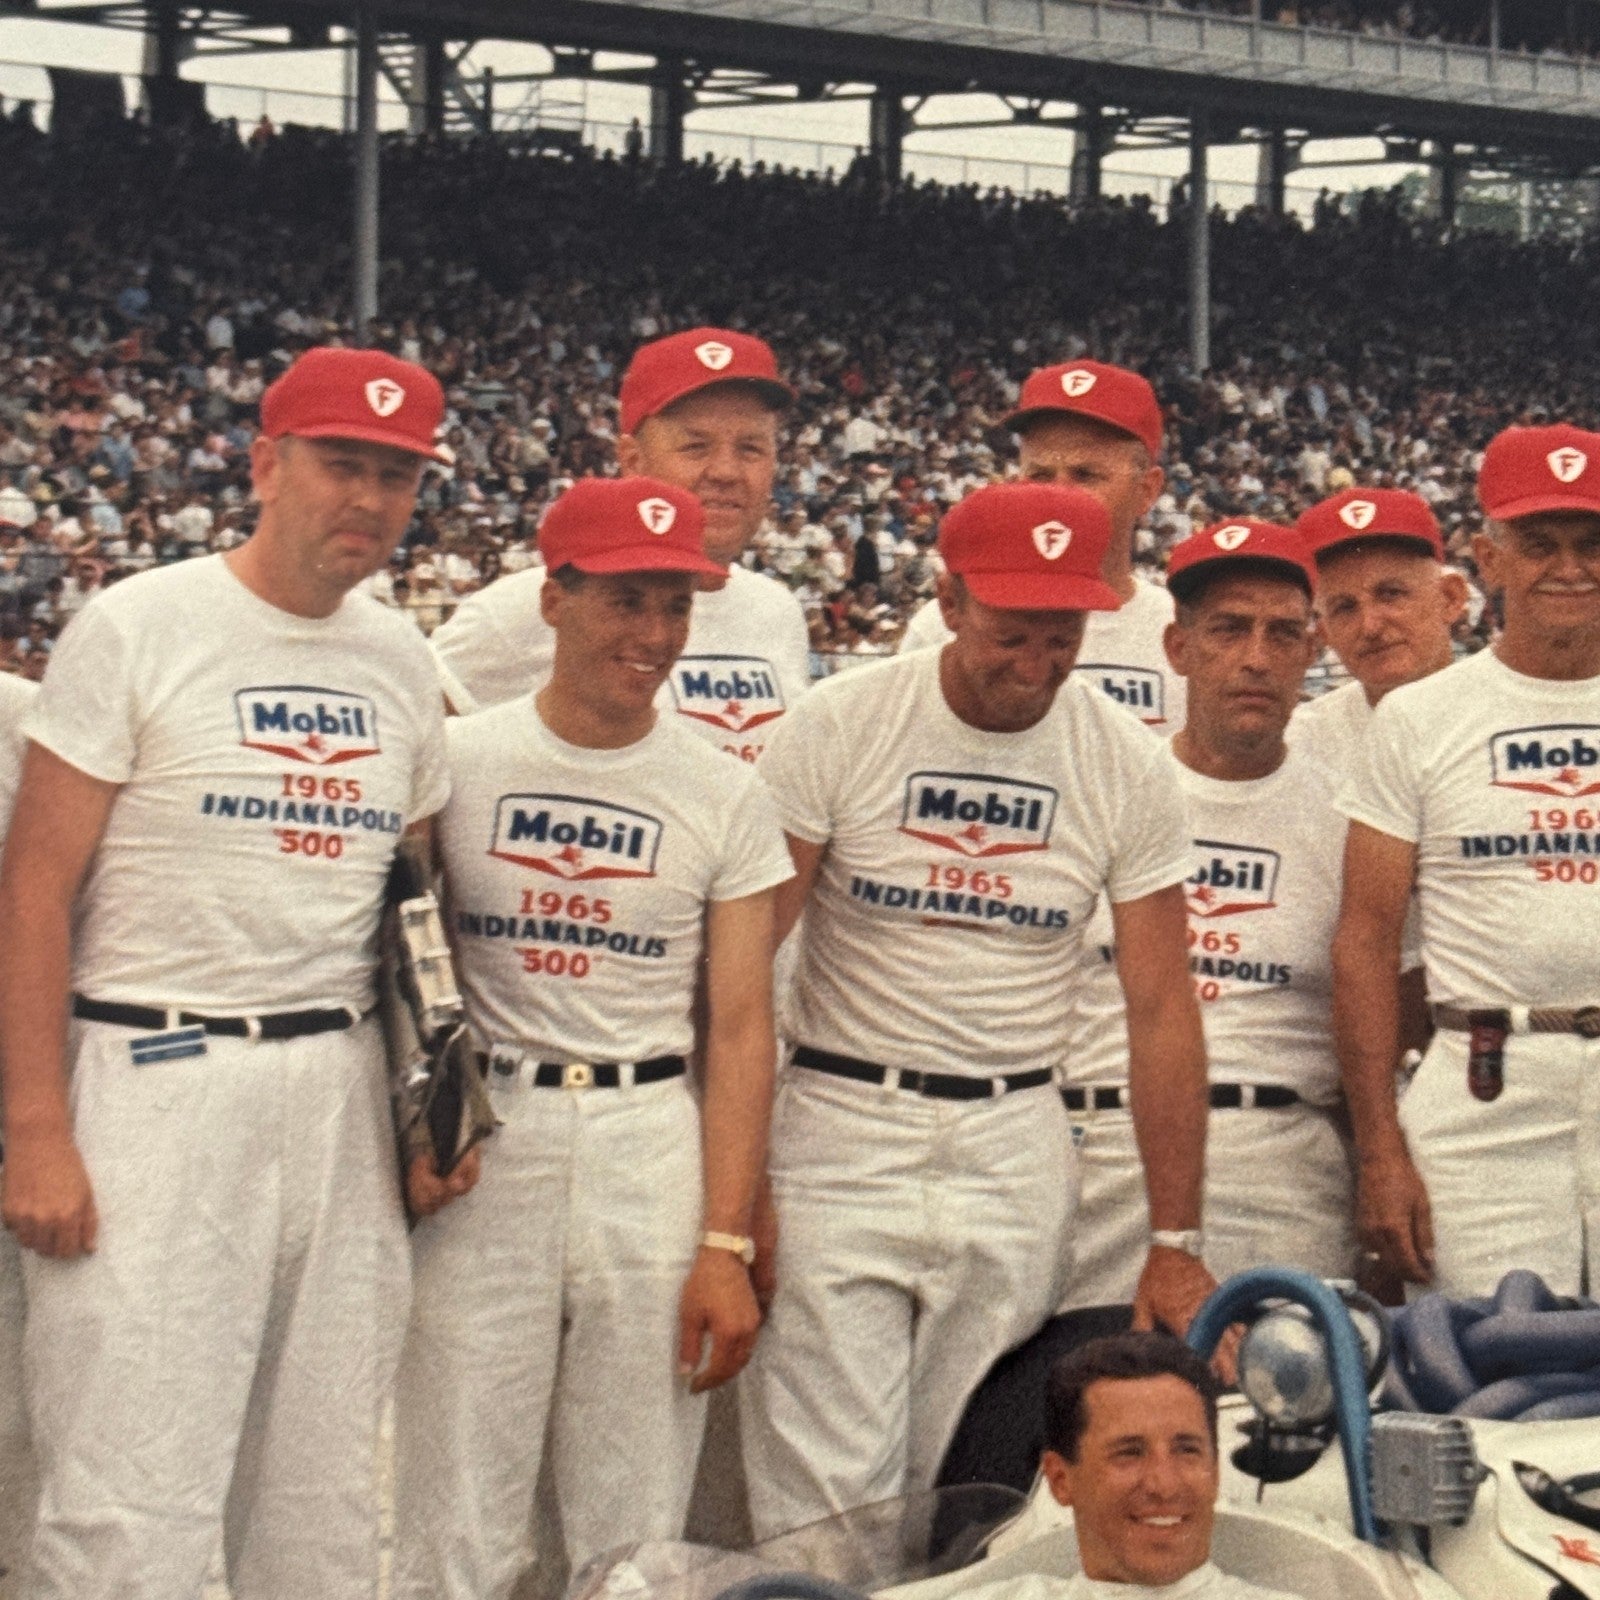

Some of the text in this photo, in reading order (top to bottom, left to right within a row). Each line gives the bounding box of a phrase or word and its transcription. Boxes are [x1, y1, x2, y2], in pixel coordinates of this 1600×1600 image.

[375, 385, 399, 409] F
[650, 504, 670, 527] F
[1044, 528, 1066, 552] F
[681, 671, 775, 699] Mobil
[1103, 678, 1152, 708] bil
[252, 702, 368, 737] Mobil
[1506, 738, 1600, 770] Mob
[281, 773, 363, 803] 1965
[918, 787, 1042, 831] Mobil
[1528, 808, 1600, 831] 196
[273, 828, 344, 859] 500
[508, 809, 646, 859] Mobil
[926, 863, 1013, 898] 1965
[1526, 858, 1598, 884] 500
[518, 889, 613, 924] 1965
[851, 876, 1070, 929] INDIANAPOLIS
[514, 948, 590, 978] 500
